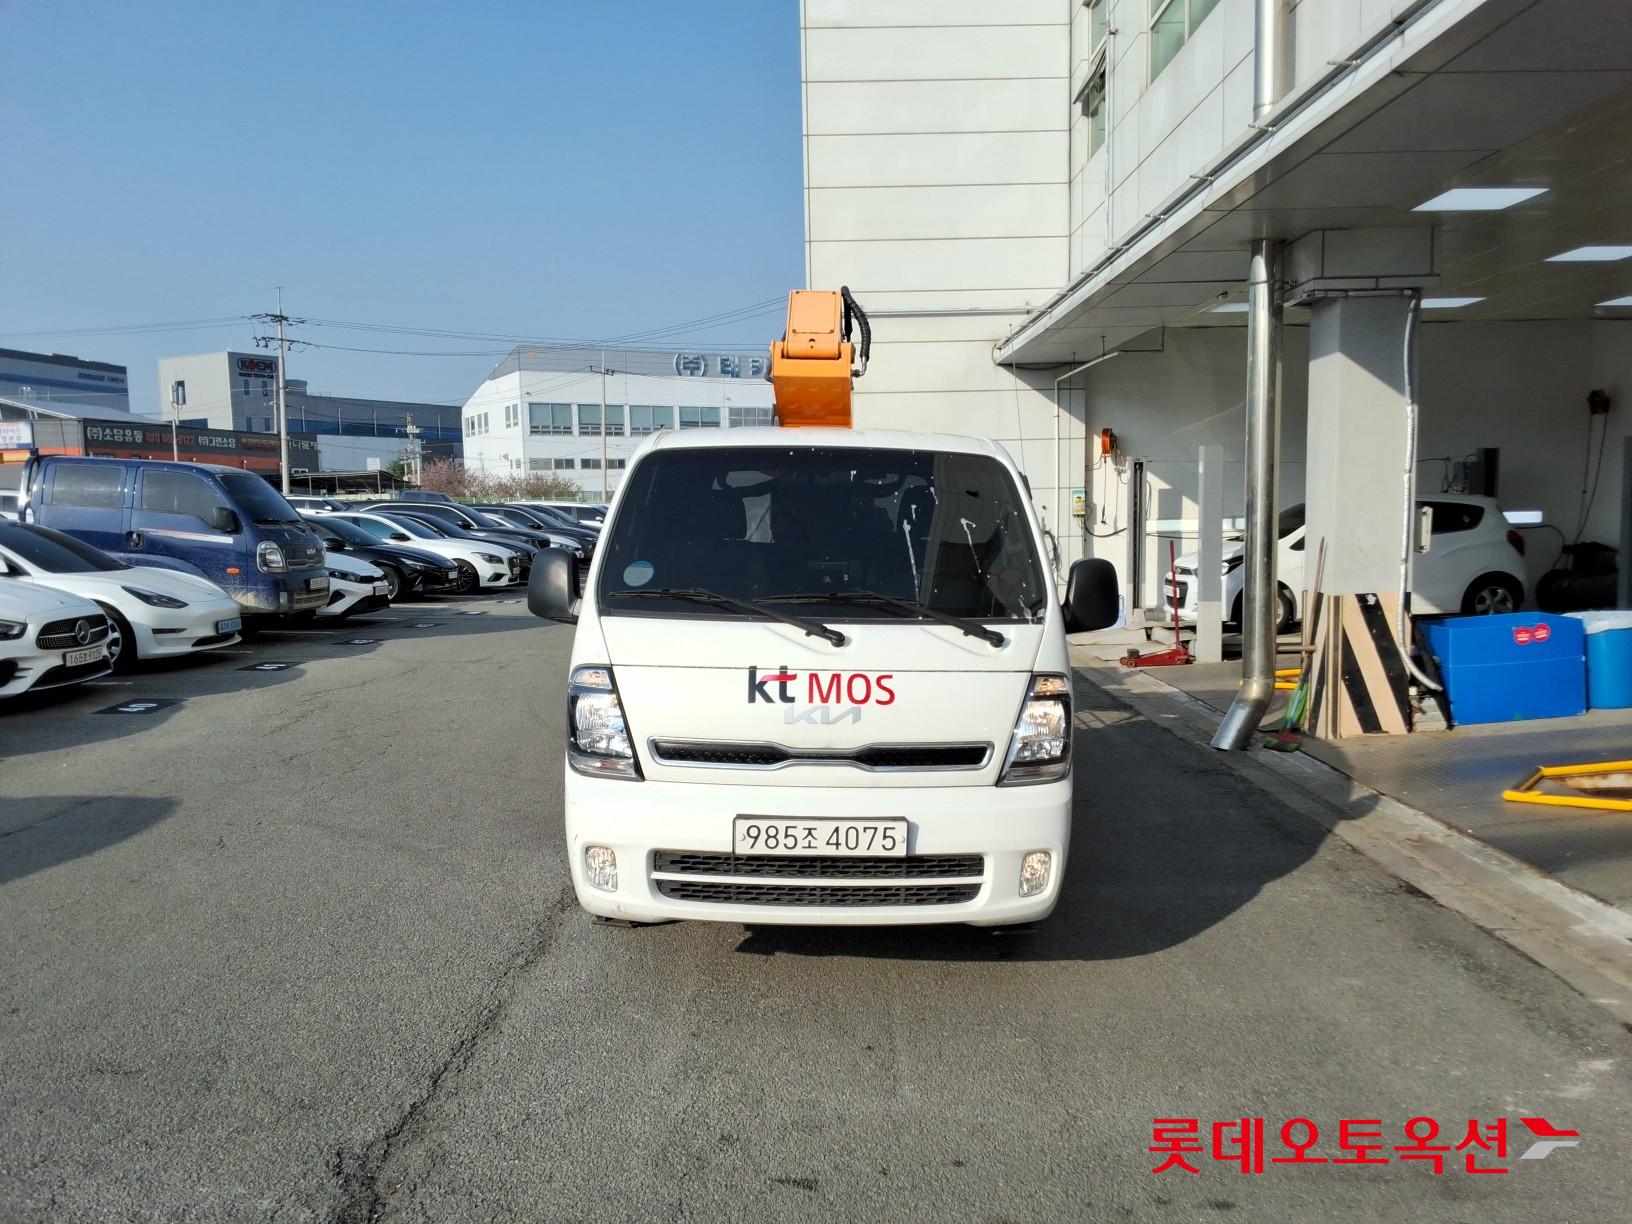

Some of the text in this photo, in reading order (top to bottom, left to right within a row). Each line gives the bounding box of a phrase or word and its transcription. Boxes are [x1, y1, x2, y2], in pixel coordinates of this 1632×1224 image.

[747, 665, 896, 705] kt MOS
[746, 824, 897, 851] 985조 4075
